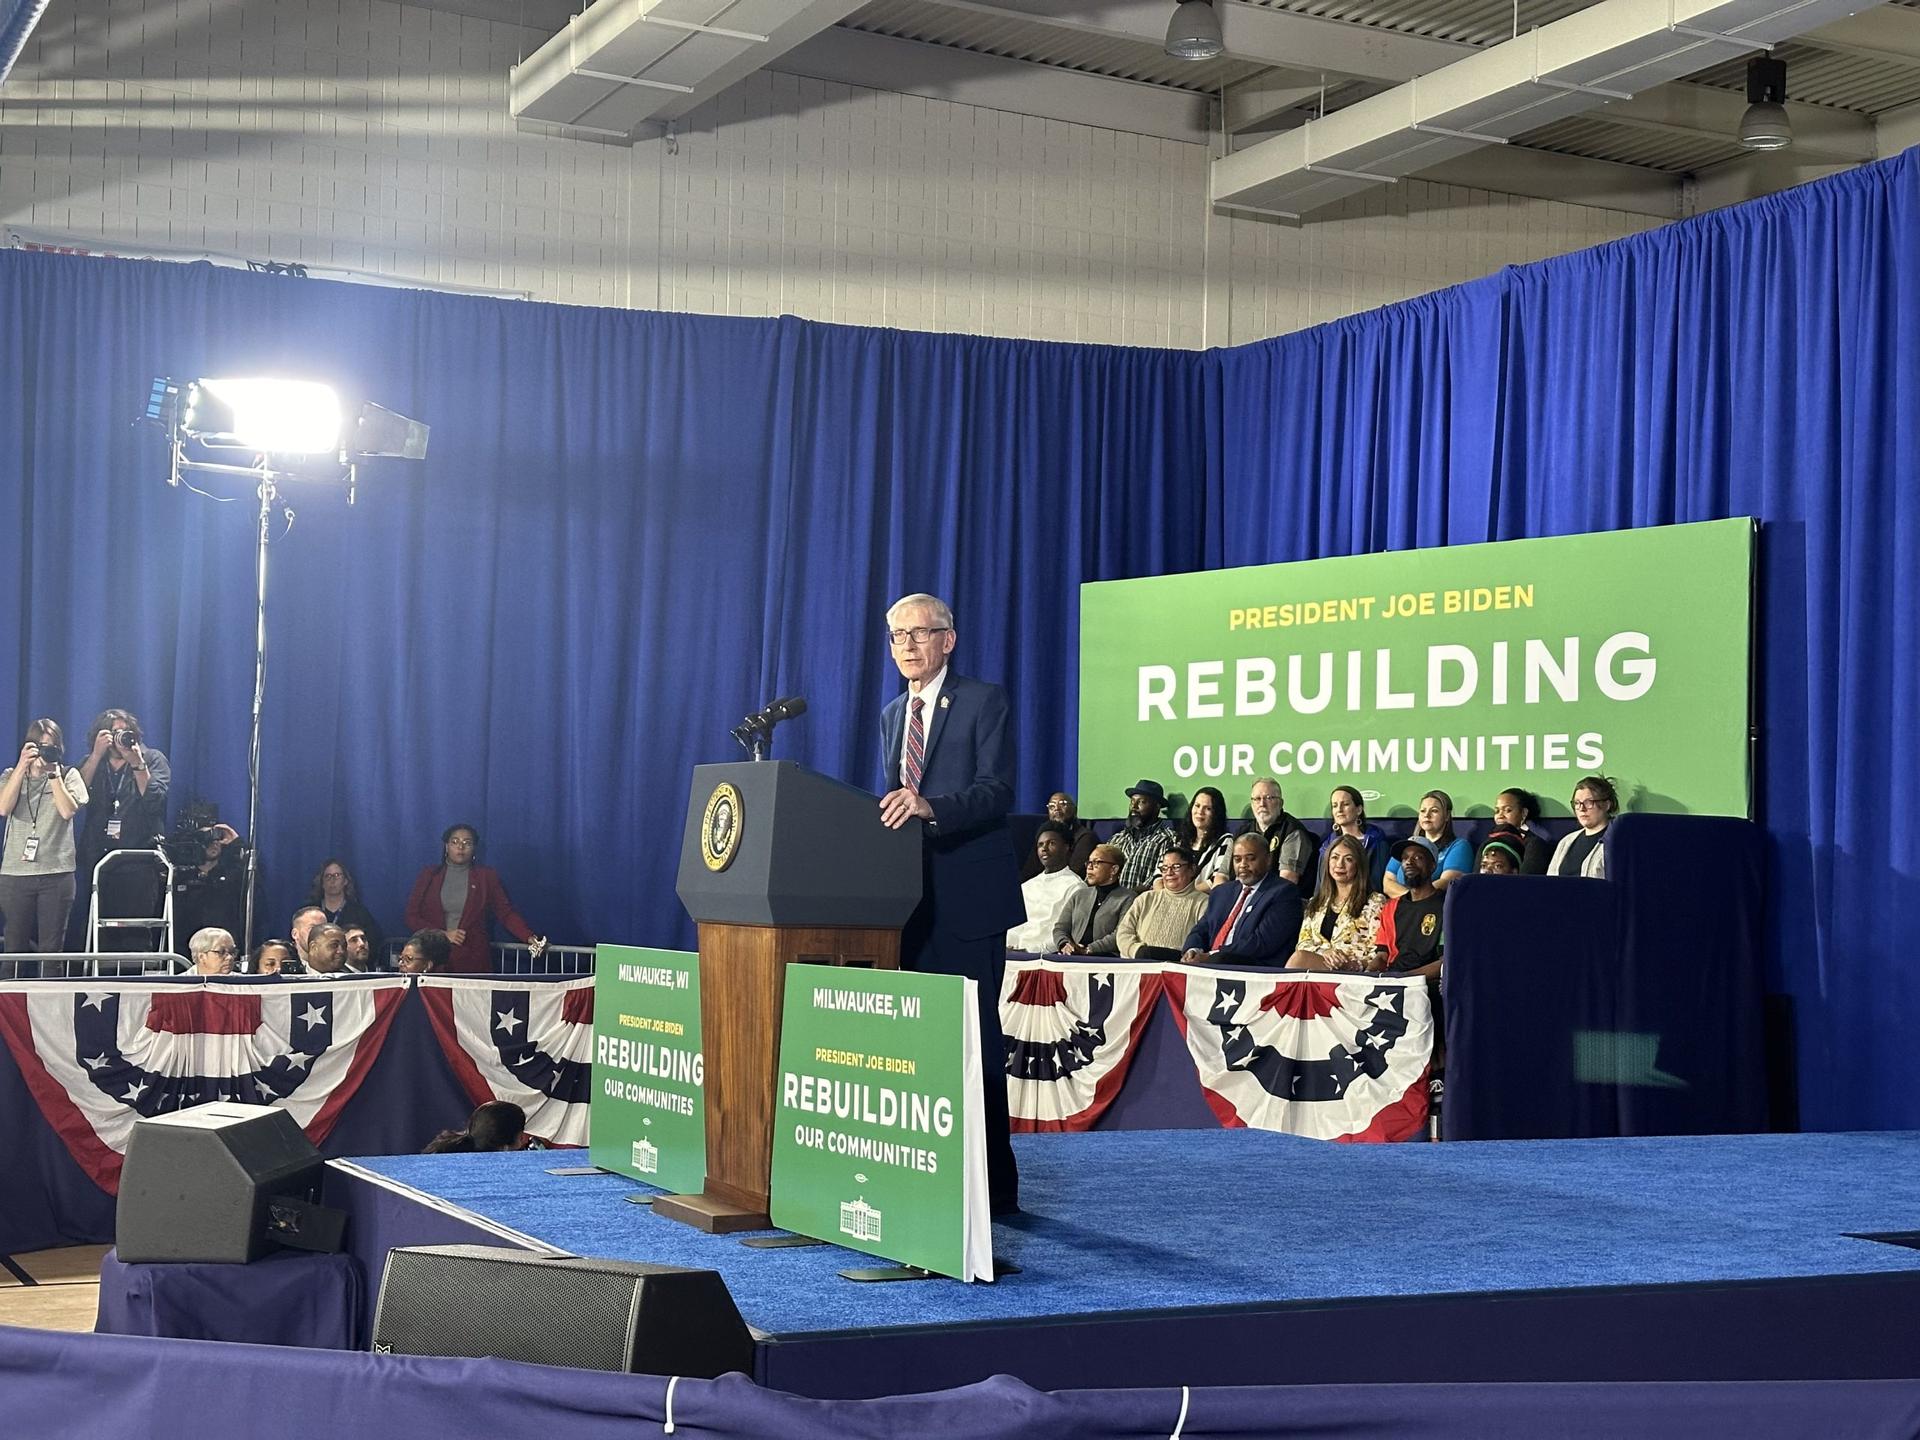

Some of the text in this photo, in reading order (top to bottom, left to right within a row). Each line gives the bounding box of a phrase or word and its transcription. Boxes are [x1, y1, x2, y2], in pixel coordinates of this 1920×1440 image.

[1229, 583, 1534, 631] PRESIDENT JOE BIDEN
[1138, 631, 1658, 722] REBUILDING
[1173, 732, 1605, 778] OUR COMMUNITIES
[618, 963, 690, 991] MILWAUKEE, WI
[618, 1013, 684, 1037] PRESIDENT JOE BIDEN
[813, 987, 921, 1021] MILWAUKEE, WI
[597, 1034, 705, 1087] REBUILDING
[815, 1047, 916, 1076] PRESIDENT JOE BIDEN
[604, 1078, 694, 1117] OUR COMMUNITIES
[783, 1072, 954, 1138] REBUILDING
[794, 1124, 938, 1174] OUR COMMUNITIES
